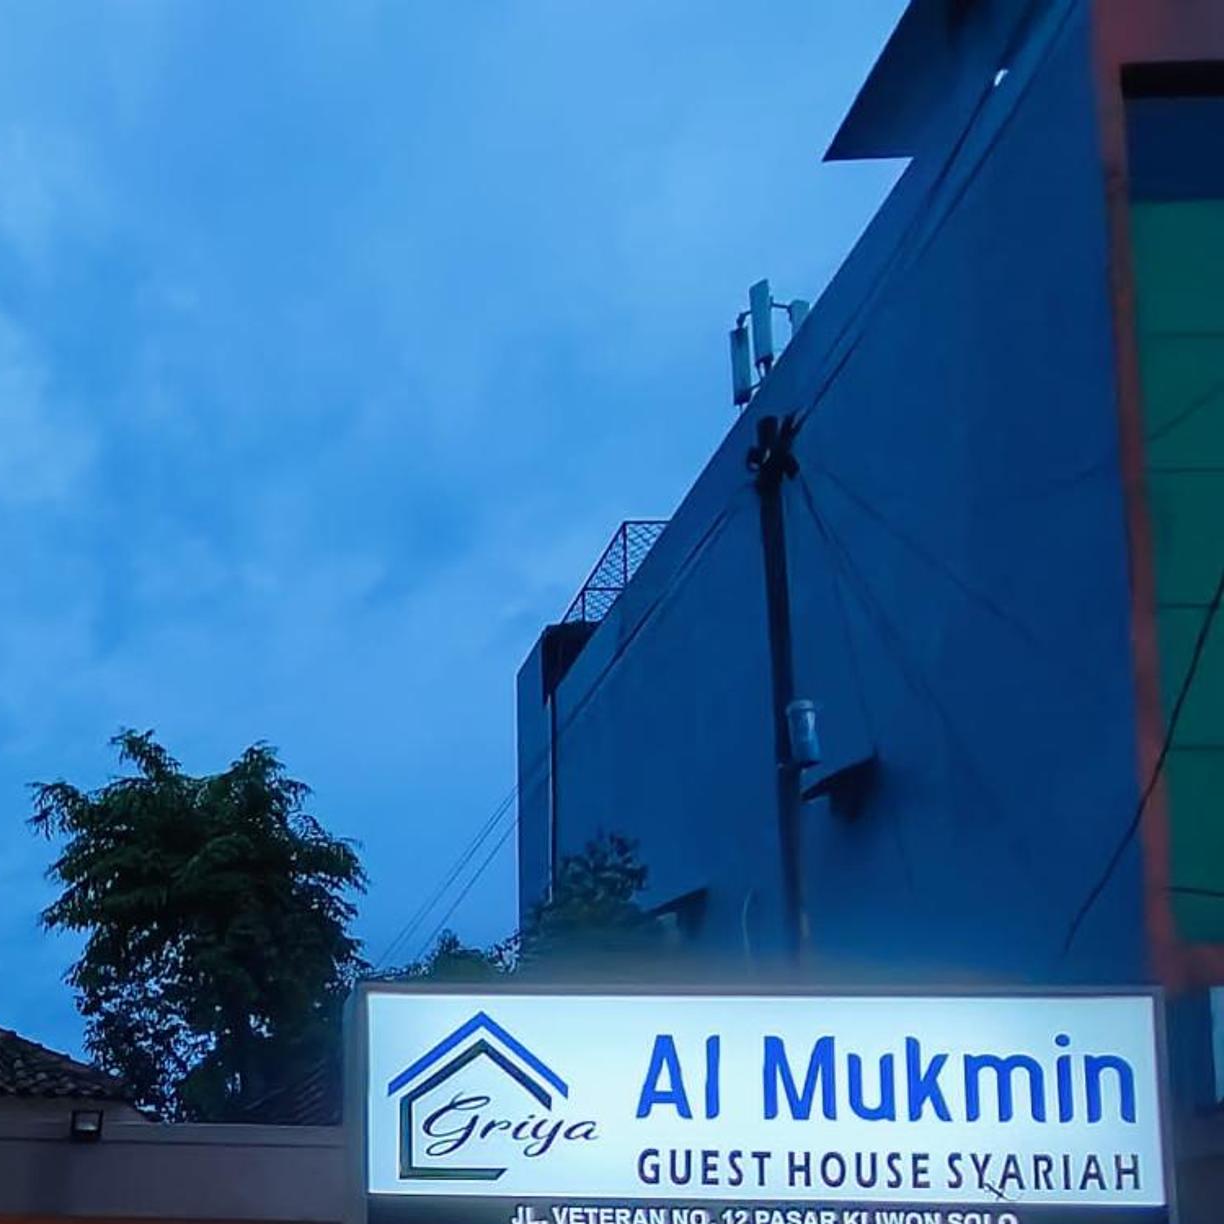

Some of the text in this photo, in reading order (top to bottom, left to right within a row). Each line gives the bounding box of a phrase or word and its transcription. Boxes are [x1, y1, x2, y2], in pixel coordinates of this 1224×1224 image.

[636, 1034, 1136, 1124] Al Mukmin
[422, 1092, 599, 1158] Griya
[638, 1148, 1140, 1190] GUEST HOUSE SYARIAH
